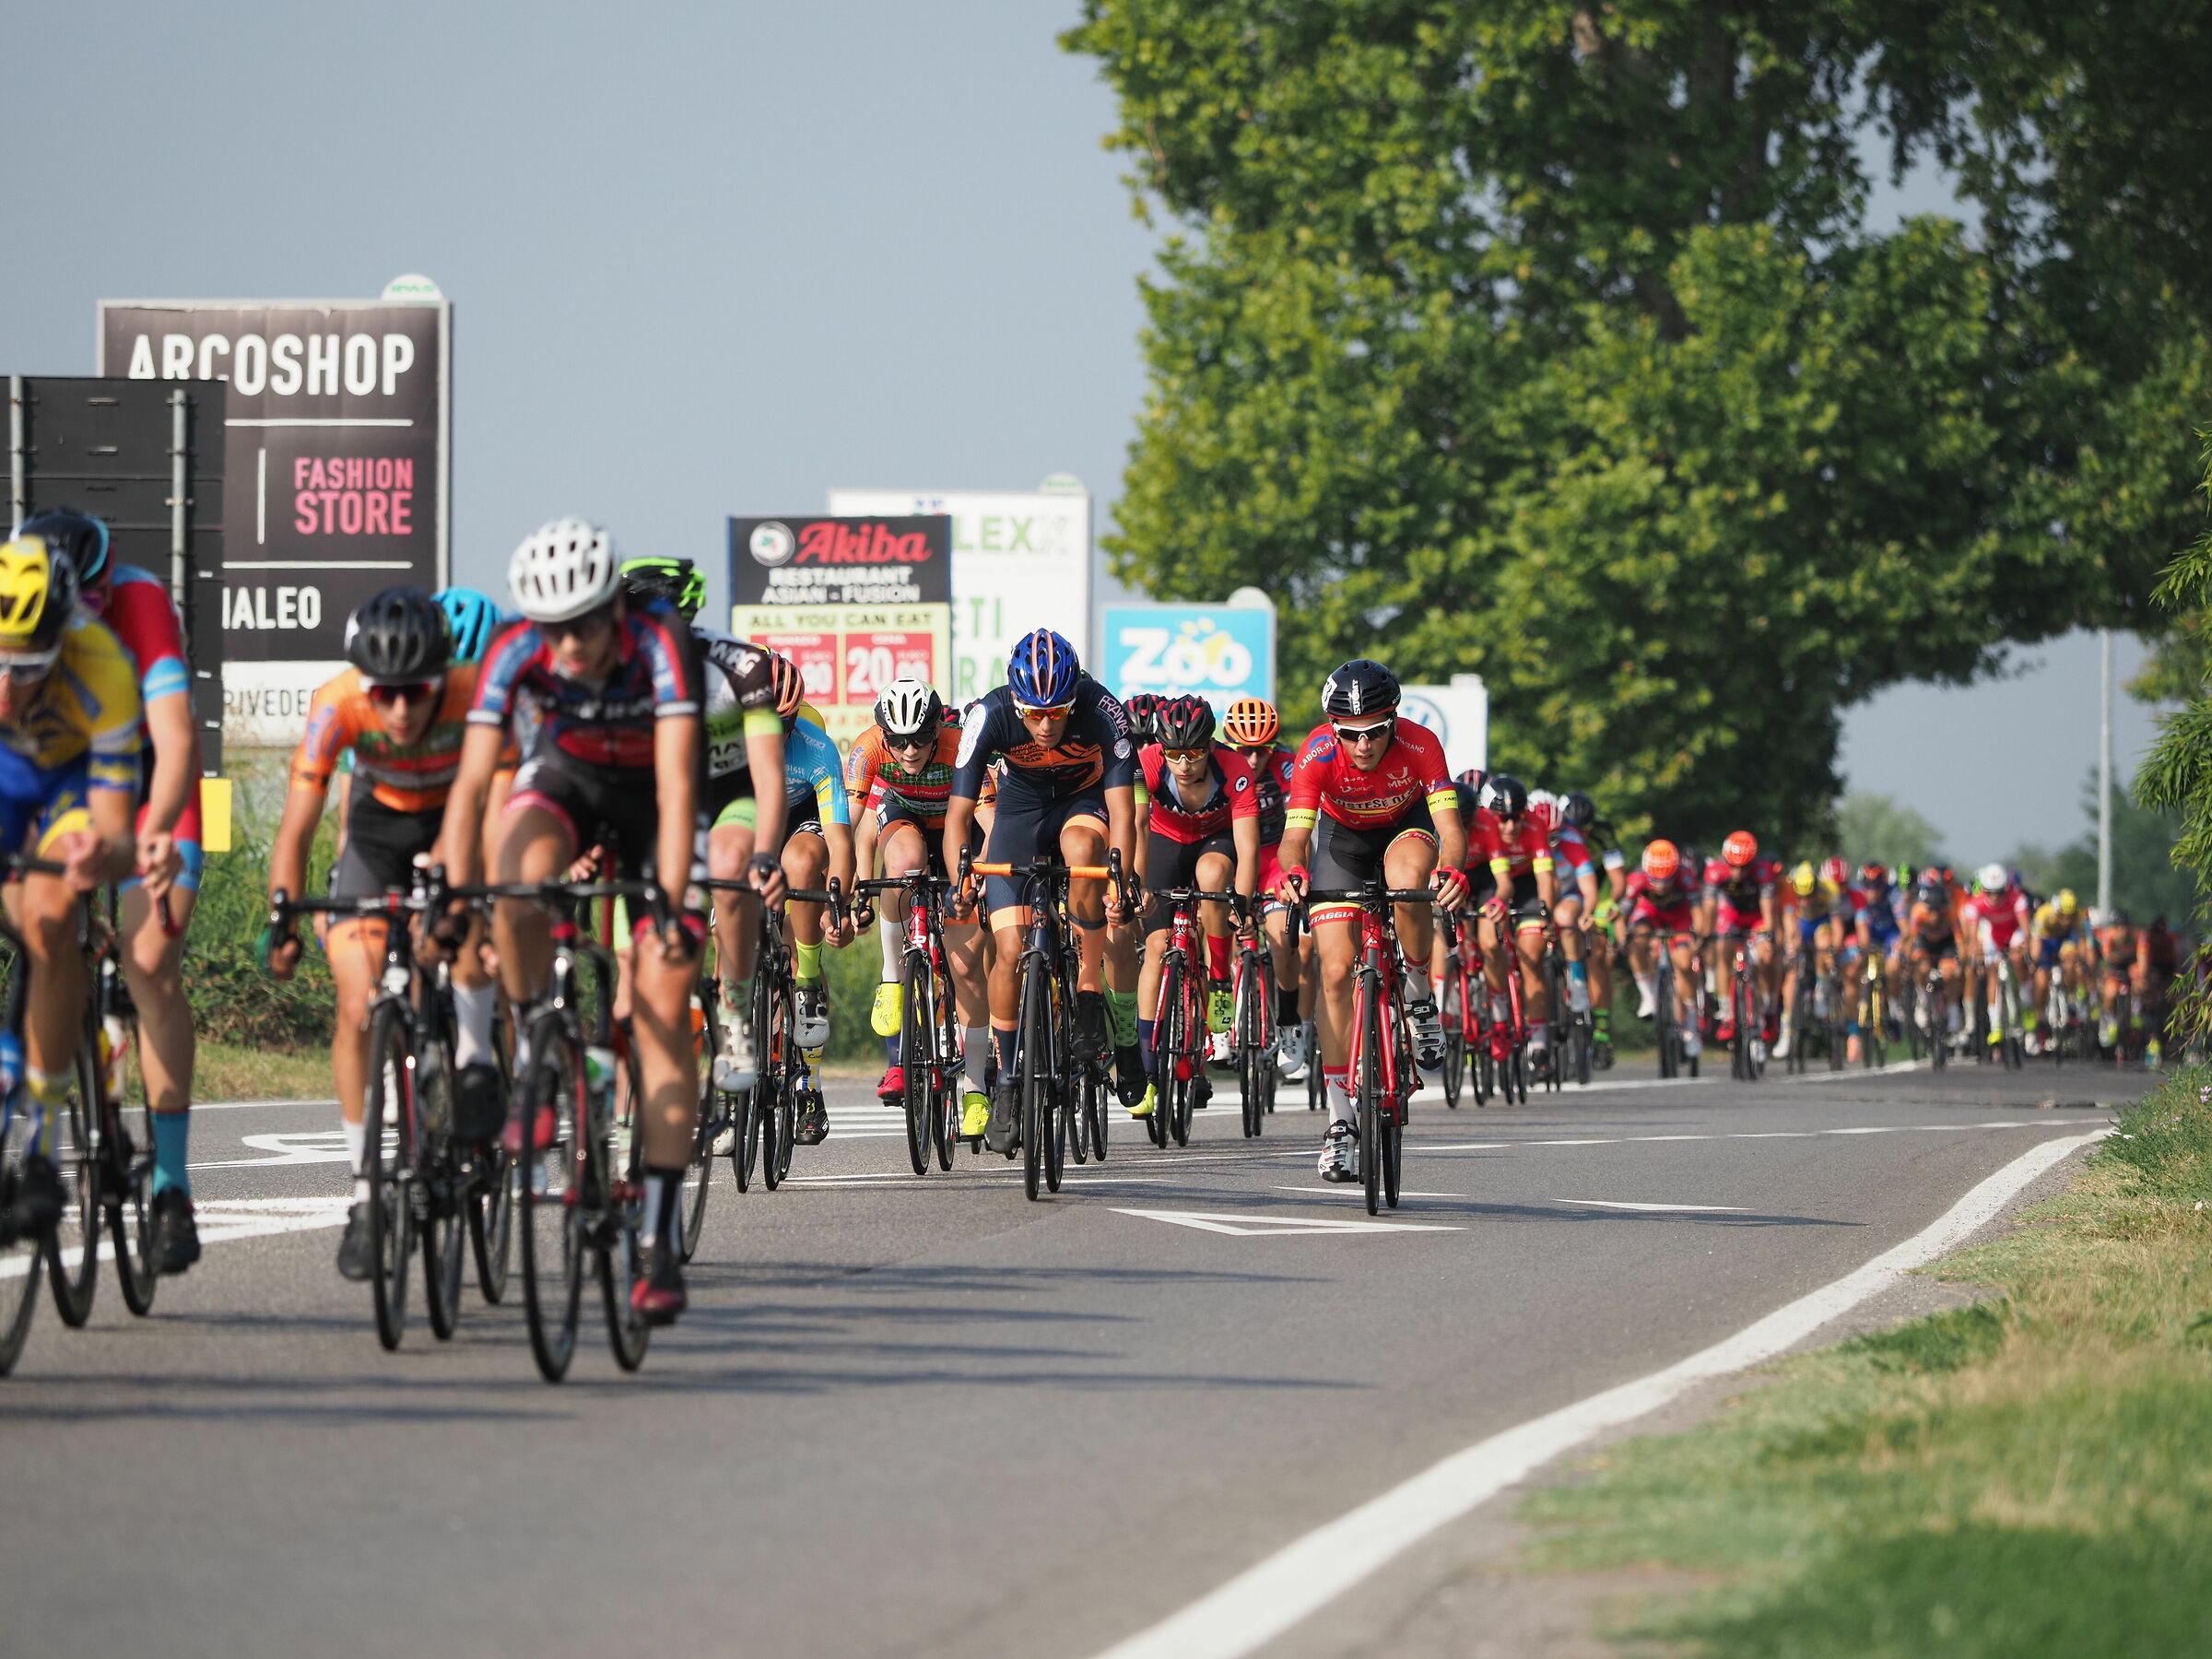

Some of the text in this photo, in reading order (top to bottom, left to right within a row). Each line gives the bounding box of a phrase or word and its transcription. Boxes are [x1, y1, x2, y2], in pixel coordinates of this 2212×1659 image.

[127, 333, 415, 396] ARCOSHOP
[295, 457, 414, 489] FASHION
[295, 489, 413, 535] STORE
[794, 521, 933, 563] Akiba
[761, 585, 828, 604] ASIAN
[841, 584, 920, 603] FUSION
[769, 566, 913, 587] RESTAURANT
[751, 614, 933, 628] ALL YOU CAN EAT
[847, 646, 894, 694] 20
